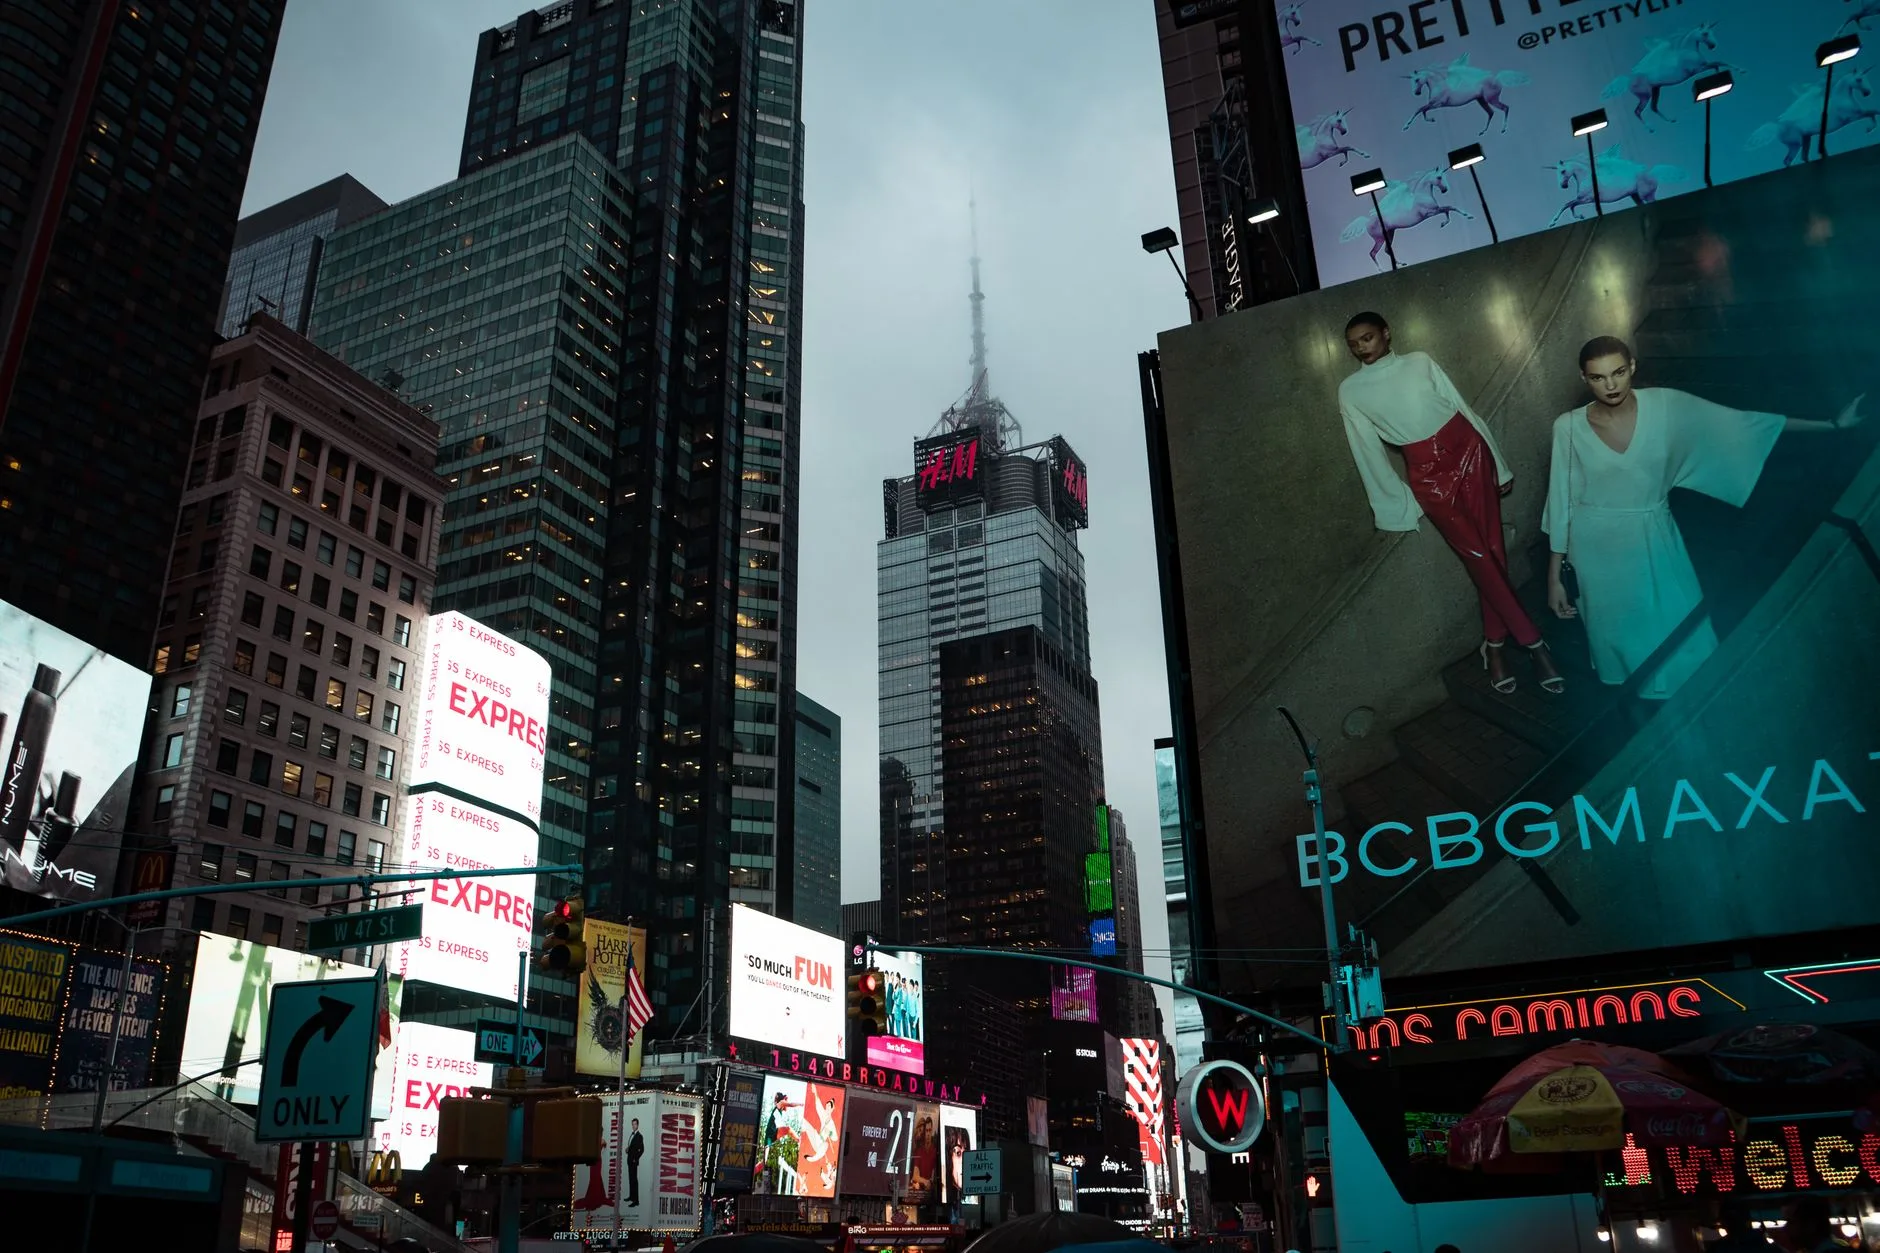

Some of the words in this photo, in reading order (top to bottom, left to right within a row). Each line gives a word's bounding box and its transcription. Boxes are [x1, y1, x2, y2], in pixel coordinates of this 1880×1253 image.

[1517, 0, 1682, 49] @PRETTYLI
[1221, 213, 1245, 309] EAGLE
[919, 438, 979, 493] H&M
[1063, 457, 1088, 511] H&M
[470, 627, 516, 657] EXPRESS
[465, 668, 512, 698] EXPRESS
[449, 681, 546, 756] EXPRES
[456, 748, 505, 776] EXPRESS
[411, 792, 425, 851] XPRESS
[451, 806, 500, 833] EXPRESS
[1296, 751, 1880, 887] BCBGMAXA
[334, 923, 348, 942] W
[355, 918, 373, 937] 47
[380, 915, 395, 935] St
[438, 940, 489, 963] EXPRESS
[592, 946, 634, 967] POTTE
[853, 957, 863, 965] LG
[104, 967, 155, 995] AUDENCE
[763, 959, 792, 978] MUCH
[0, 968, 62, 1001] ADWAY
[90, 987, 138, 1015] REACES
[68, 1007, 78, 1029] A
[79, 1008, 113, 1034] FEVER
[486, 1033, 509, 1051] ONE
[1081, 1049, 1097, 1058] STOLEN
[426, 1056, 478, 1076] EXPRESS
[273, 1094, 350, 1127] ONLY
[1206, 1087, 1250, 1133] W
[862, 1125, 882, 1139] FOREVER
[885, 1109, 915, 1175] 21
[659, 1113, 679, 1193] WOMAN
[678, 1113, 696, 1197] PRETTY
[720, 1151, 753, 1169] AWAY
[975, 1152, 988, 1161] ALL
[969, 1162, 994, 1173] TRAFFIC
[659, 1196, 669, 1215] THE
[669, 1197, 694, 1216] MUSICAL
[553, 1231, 579, 1240] GIFTS
